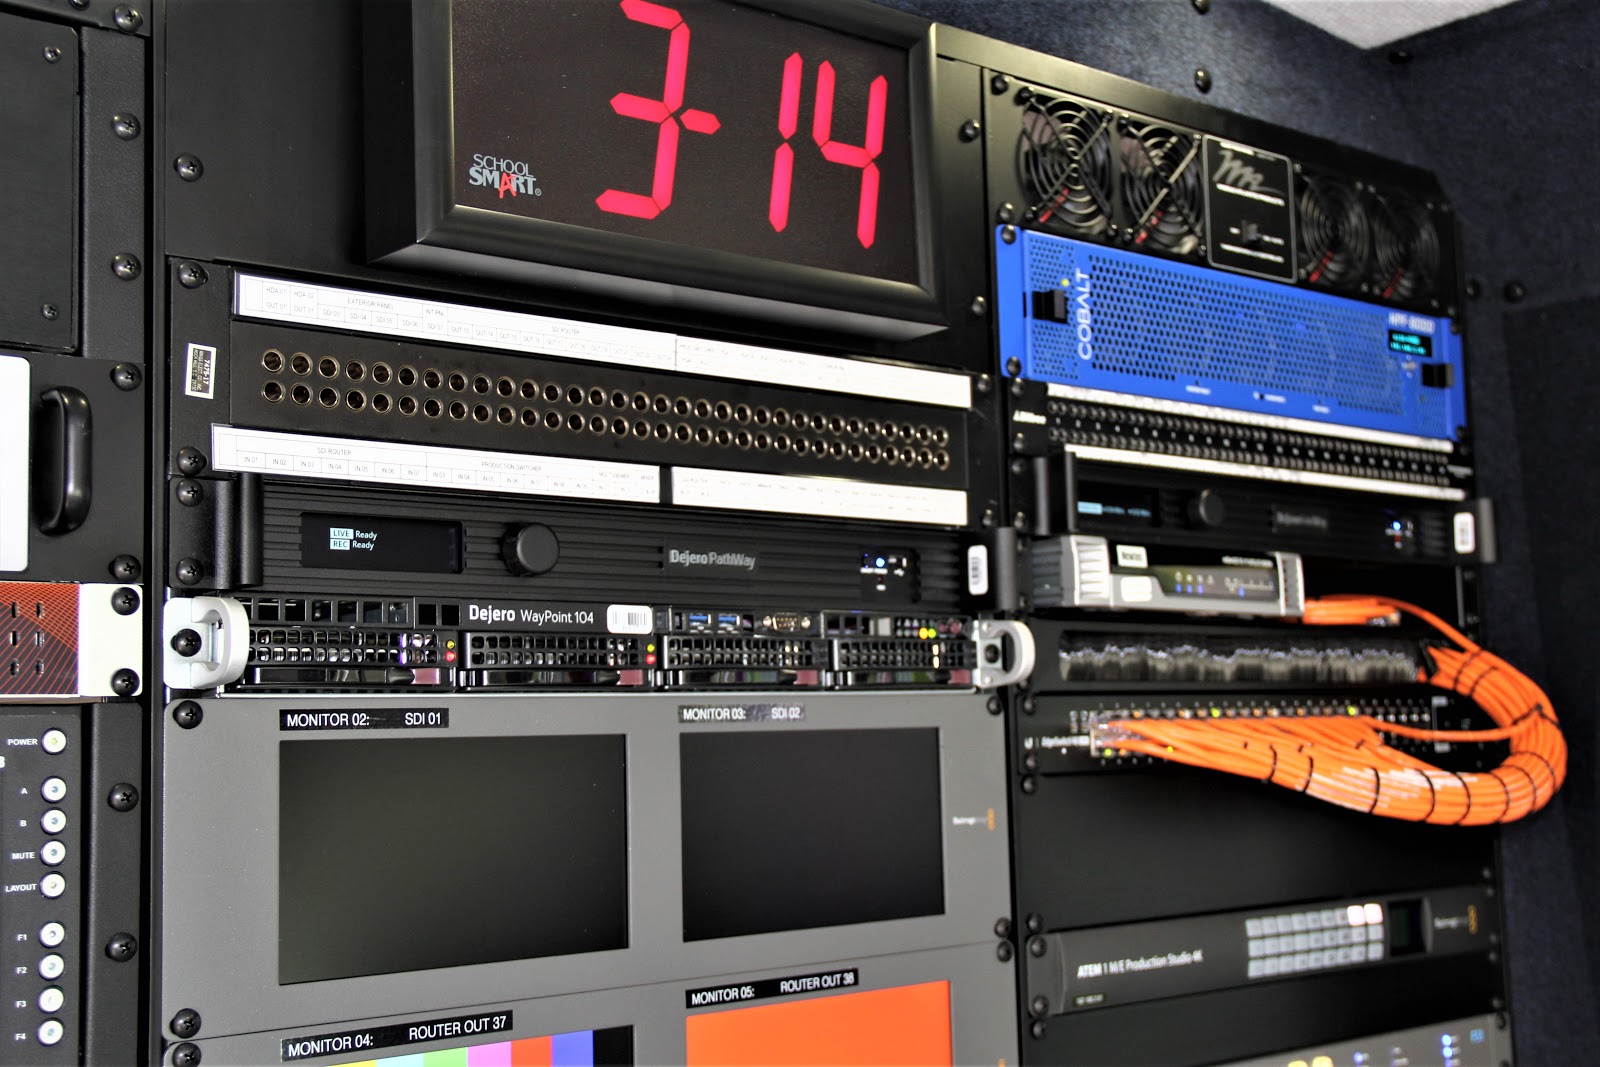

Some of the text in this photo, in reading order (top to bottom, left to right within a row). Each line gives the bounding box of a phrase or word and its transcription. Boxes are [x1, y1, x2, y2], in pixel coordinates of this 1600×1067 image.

[473, 153, 535, 177] SCHOOL
[469, 166, 537, 199] SMART
[347, 297, 376, 308] EXTERIOR
[376, 315, 386, 323] SDI
[1075, 267, 1093, 360] COBALT
[328, 448, 352, 456] ROUTER
[481, 461, 542, 472] PRODUCTION SWITCHER
[355, 530, 378, 541] Ready
[352, 540, 375, 551] Ready
[669, 549, 755, 570] Dejero PathWay
[469, 604, 594, 626] Dejero WayPoint 104
[287, 712, 441, 727] MONITOR 02: SDI 01
[683, 707, 801, 720] MONITOR 03: SDI 02
[7, 738, 38, 746] POWER
[12, 852, 35, 860] MUTE
[5, 883, 37, 892] LAYOUT
[1077, 962, 1103, 979] ATEM
[1125, 955, 1167, 973] Production
[1167, 951, 1192, 967] Studio
[692, 972, 855, 1005] MONITOR 05: ROUTER OUT 38
[15, 1033, 26, 1041] F4
[288, 1016, 507, 1057] MONITOR 04: ROUTER OUT 37
